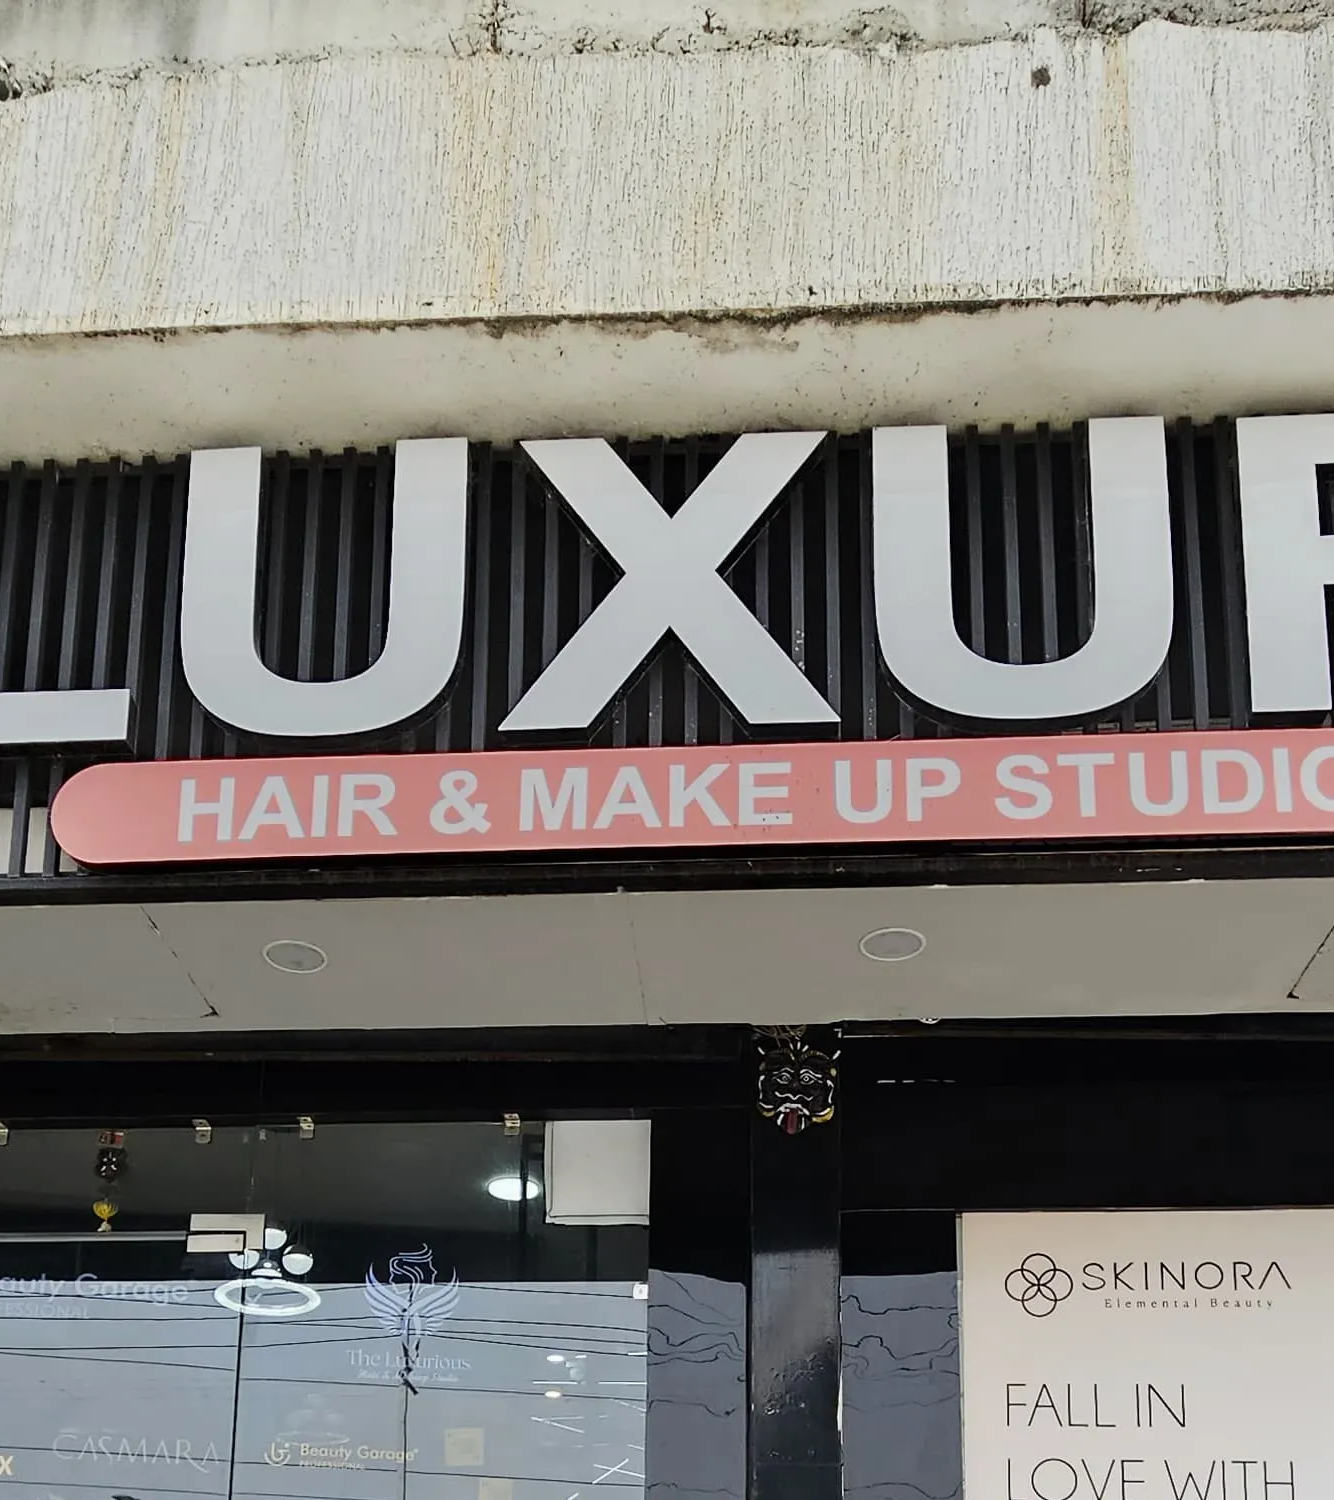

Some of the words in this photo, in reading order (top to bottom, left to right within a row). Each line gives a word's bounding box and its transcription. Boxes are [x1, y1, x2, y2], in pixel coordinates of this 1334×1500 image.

[177, 773, 398, 844] HAIR
[429, 769, 489, 835] &
[519, 761, 793, 830] MAKE
[834, 756, 962, 824] UP
[75, 1272, 189, 1307] Garage
[1081, 1261, 1292, 1291] SKINORA
[1104, 1298, 1198, 1309] Elemental
[1210, 1298, 1273, 1310] Beauty
[346, 1348, 381, 1367] The
[1006, 1383, 1116, 1428] FALL
[1135, 1383, 1186, 1428] IN
[52, 1433, 220, 1474] CASMARA
[300, 1443, 352, 1461] Beauty
[367, 1445, 415, 1464] Garage
